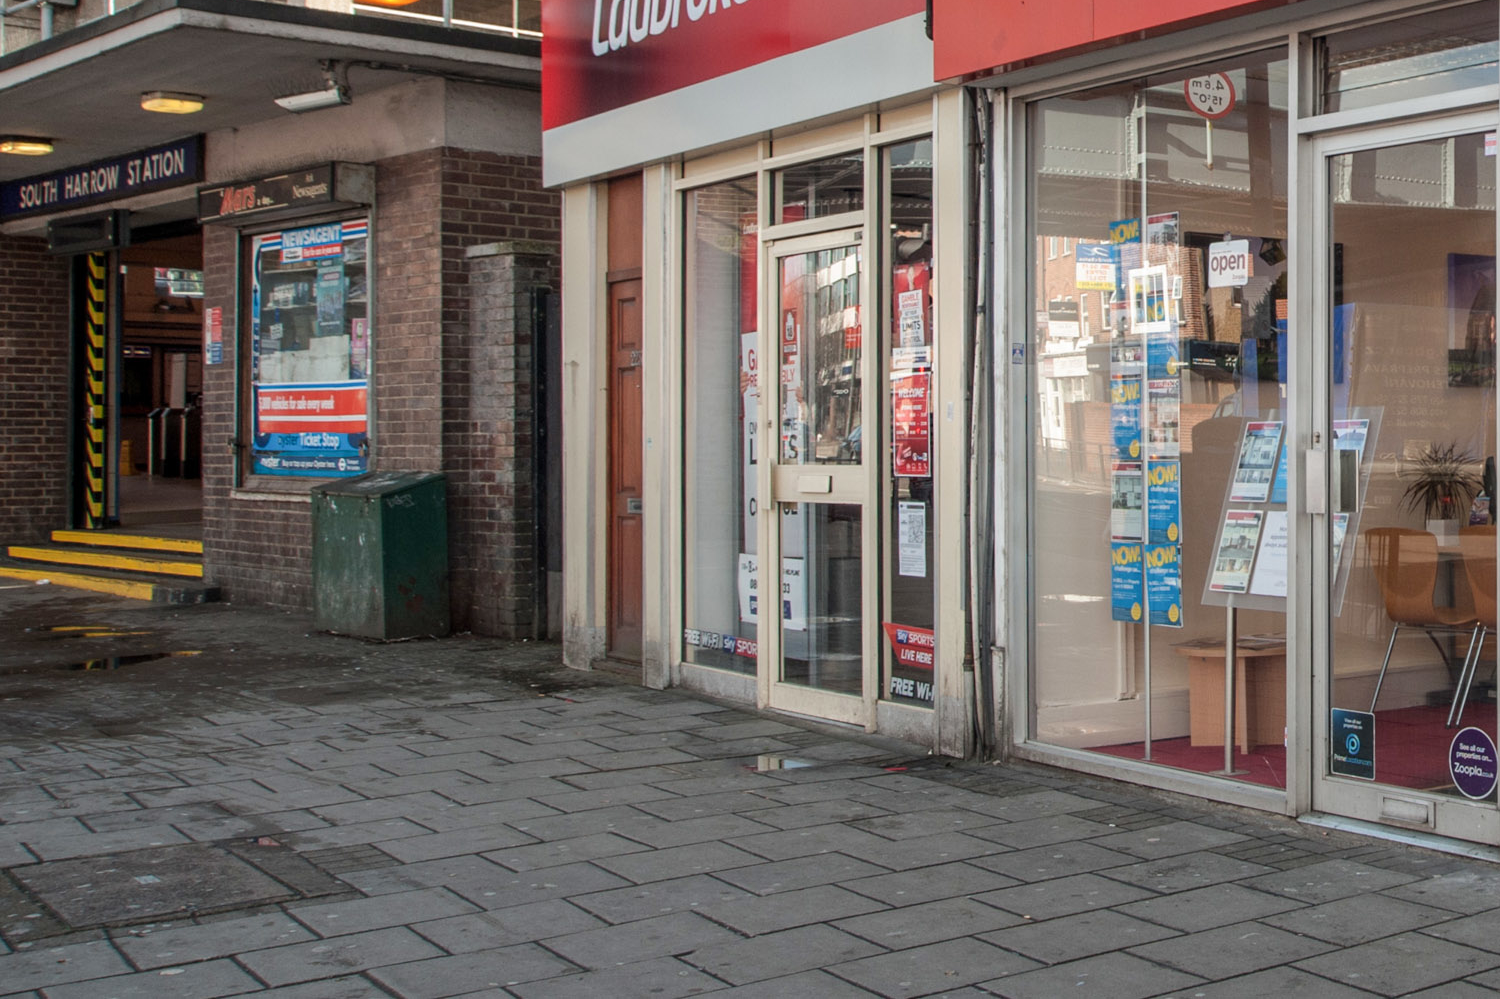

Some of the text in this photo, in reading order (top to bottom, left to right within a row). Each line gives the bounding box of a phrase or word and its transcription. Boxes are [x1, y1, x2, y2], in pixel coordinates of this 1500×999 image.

[19, 148, 185, 209] SOUTH HARROW STATION
[282, 225, 342, 247] NEWSAGENT
[1110, 220, 1139, 245] NOW!
[1210, 252, 1246, 276] open
[898, 387, 925, 398] WELCOME
[322, 432, 340, 450] Stop
[1148, 464, 1178, 487] NOW!
[1112, 545, 1141, 566] NOW!
[1146, 545, 1177, 568] NOW!
[897, 630, 934, 646] sky SPORTS
[900, 648, 932, 664] LIVE HERE
[890, 677, 914, 697] FREE
[1456, 751, 1481, 761] properties
[1459, 742, 1469, 751] See
[1476, 745, 1486, 753] our
